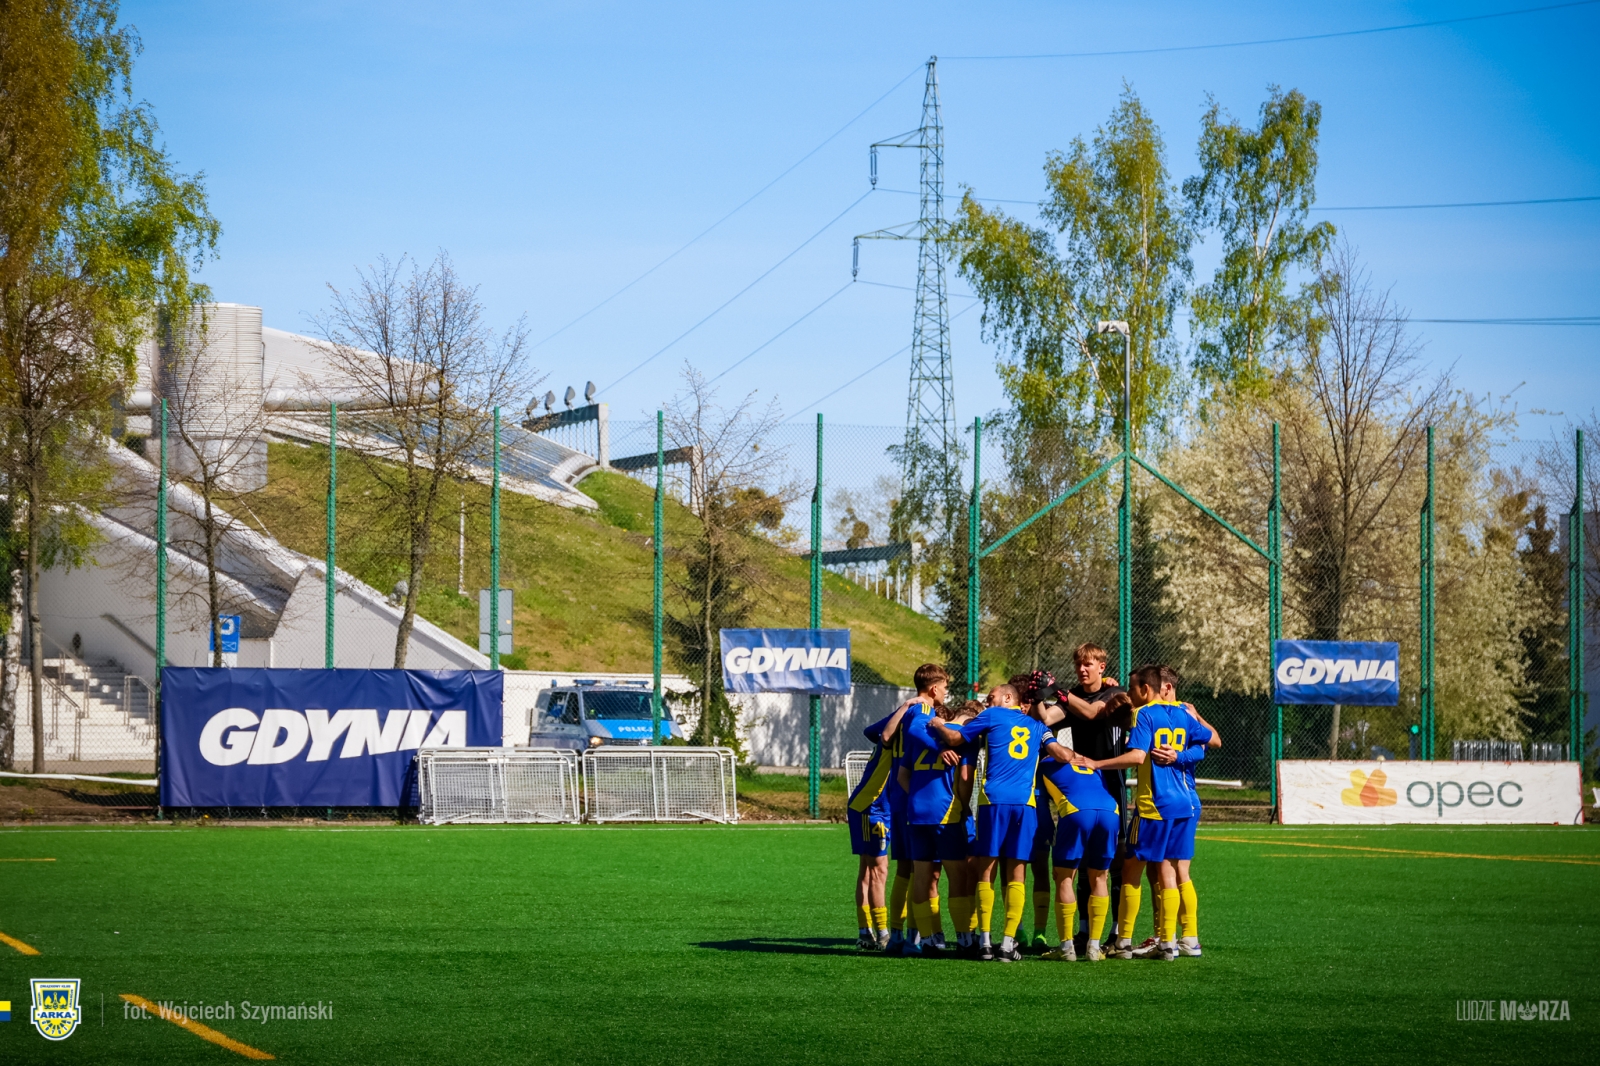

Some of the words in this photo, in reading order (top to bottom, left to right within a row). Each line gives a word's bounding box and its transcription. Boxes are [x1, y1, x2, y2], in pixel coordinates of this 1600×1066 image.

[725, 646, 848, 675] GDYNIA
[1276, 657, 1396, 686] GDYNIA
[199, 707, 467, 767] GDYNIA
[1007, 725, 1031, 760] 8
[1406, 780, 1524, 817] opec
